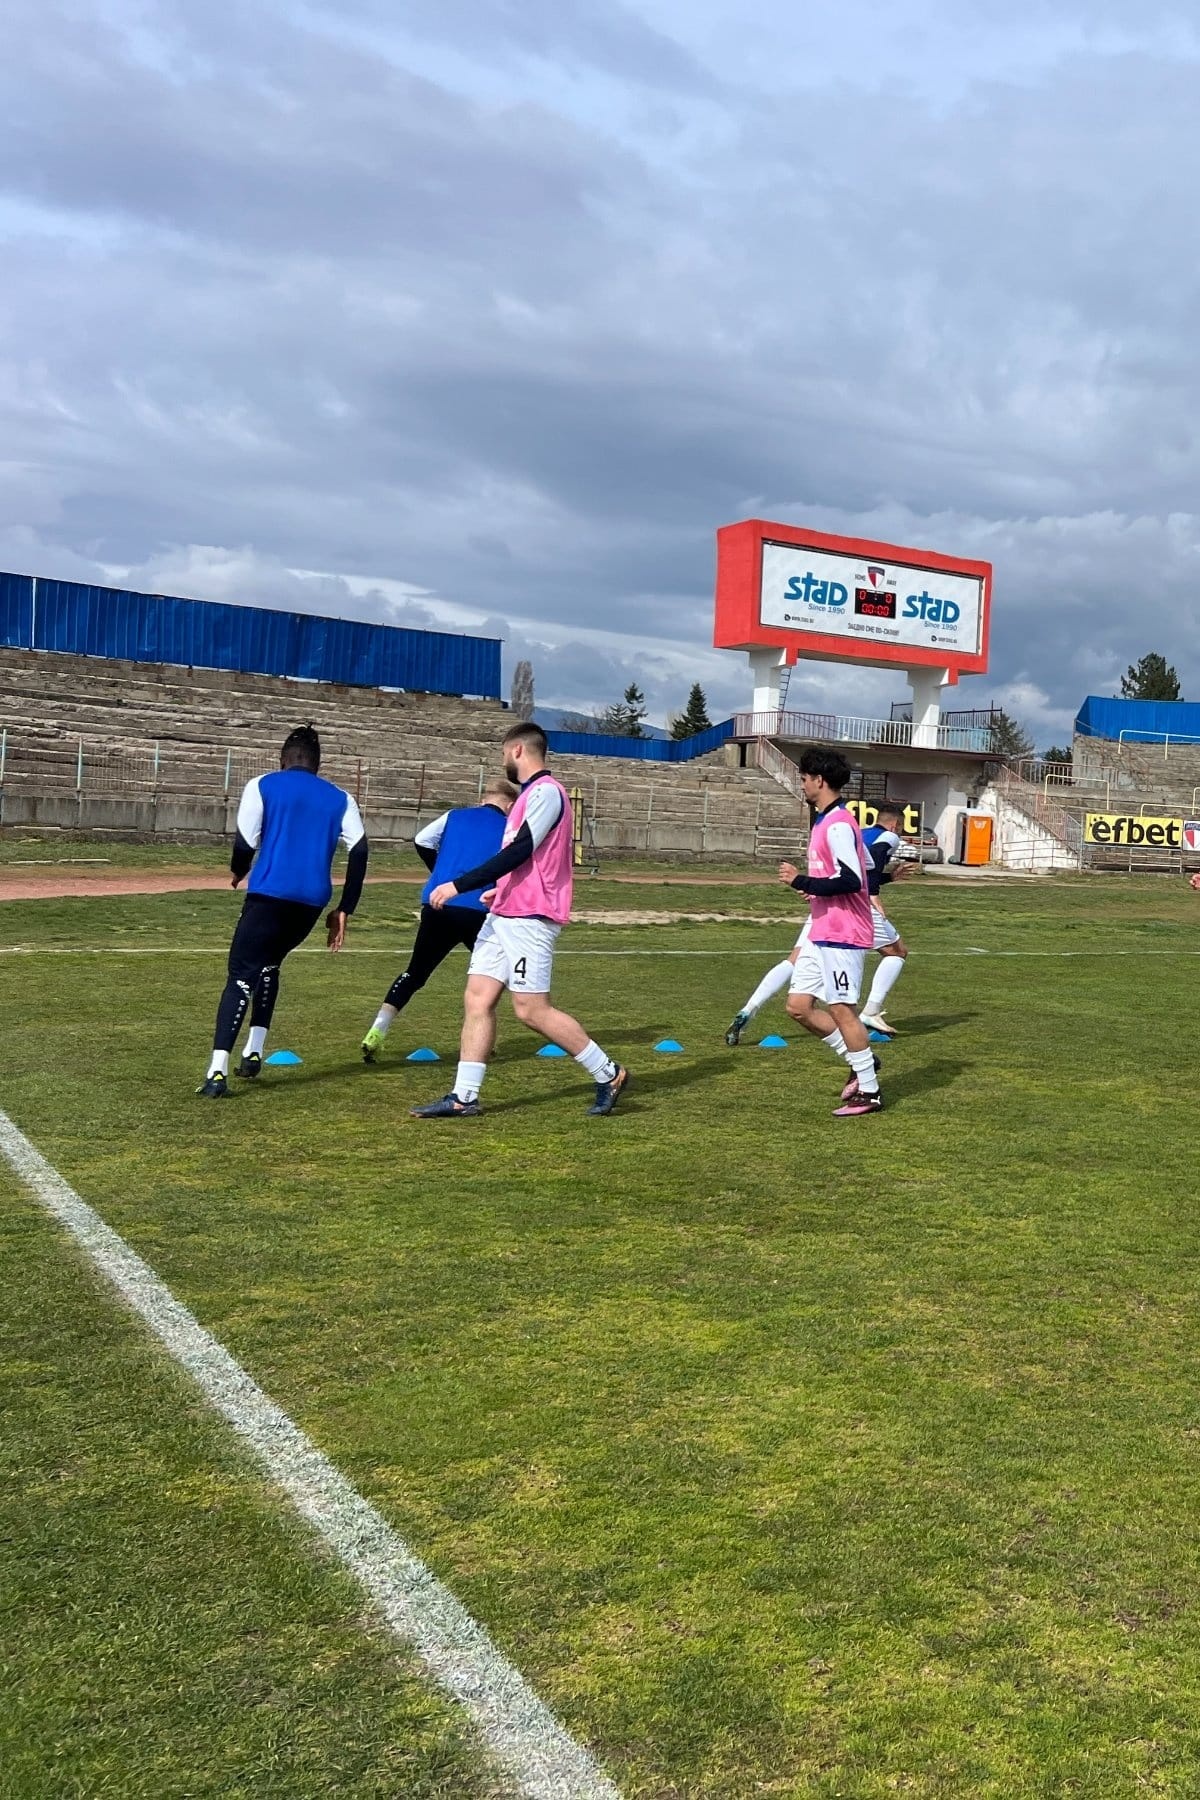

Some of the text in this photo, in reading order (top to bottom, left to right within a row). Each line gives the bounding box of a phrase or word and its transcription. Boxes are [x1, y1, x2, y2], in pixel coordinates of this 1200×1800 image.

[1090, 816, 1180, 846] efbet
[514, 956, 527, 979] 4
[833, 970, 850, 991] 14
